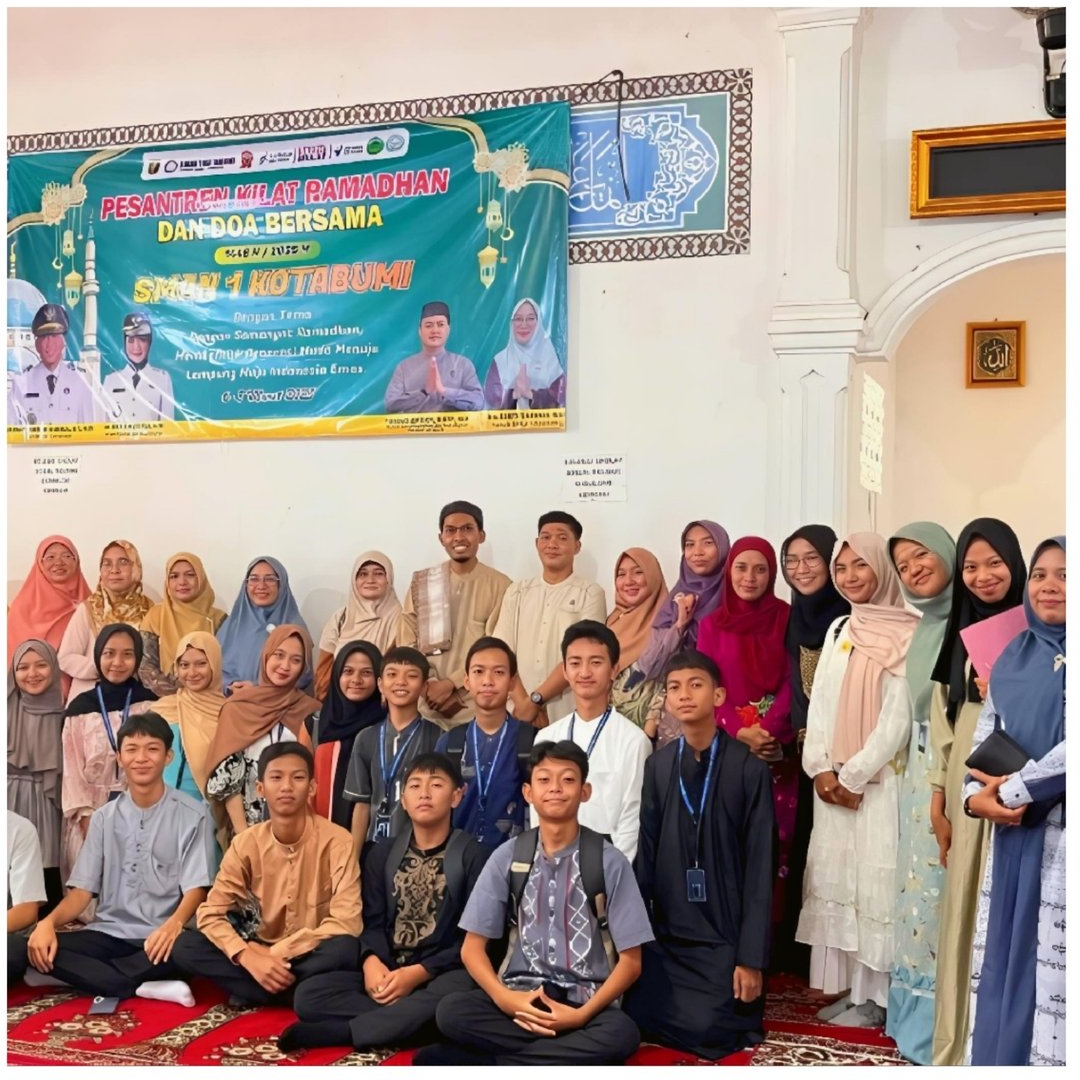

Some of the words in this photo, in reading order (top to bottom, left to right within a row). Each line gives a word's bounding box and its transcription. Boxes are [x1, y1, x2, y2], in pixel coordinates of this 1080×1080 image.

[101, 187, 229, 221] PESANTREN
[236, 180, 299, 207] KILAT
[306, 169, 450, 203] RAMADHAN
[157, 216, 204, 243] DAN
[210, 214, 259, 239] DOA
[265, 204, 385, 235] BERSAMA
[225, 270, 244, 298] 1
[247, 260, 416, 297] KOTABUMI
